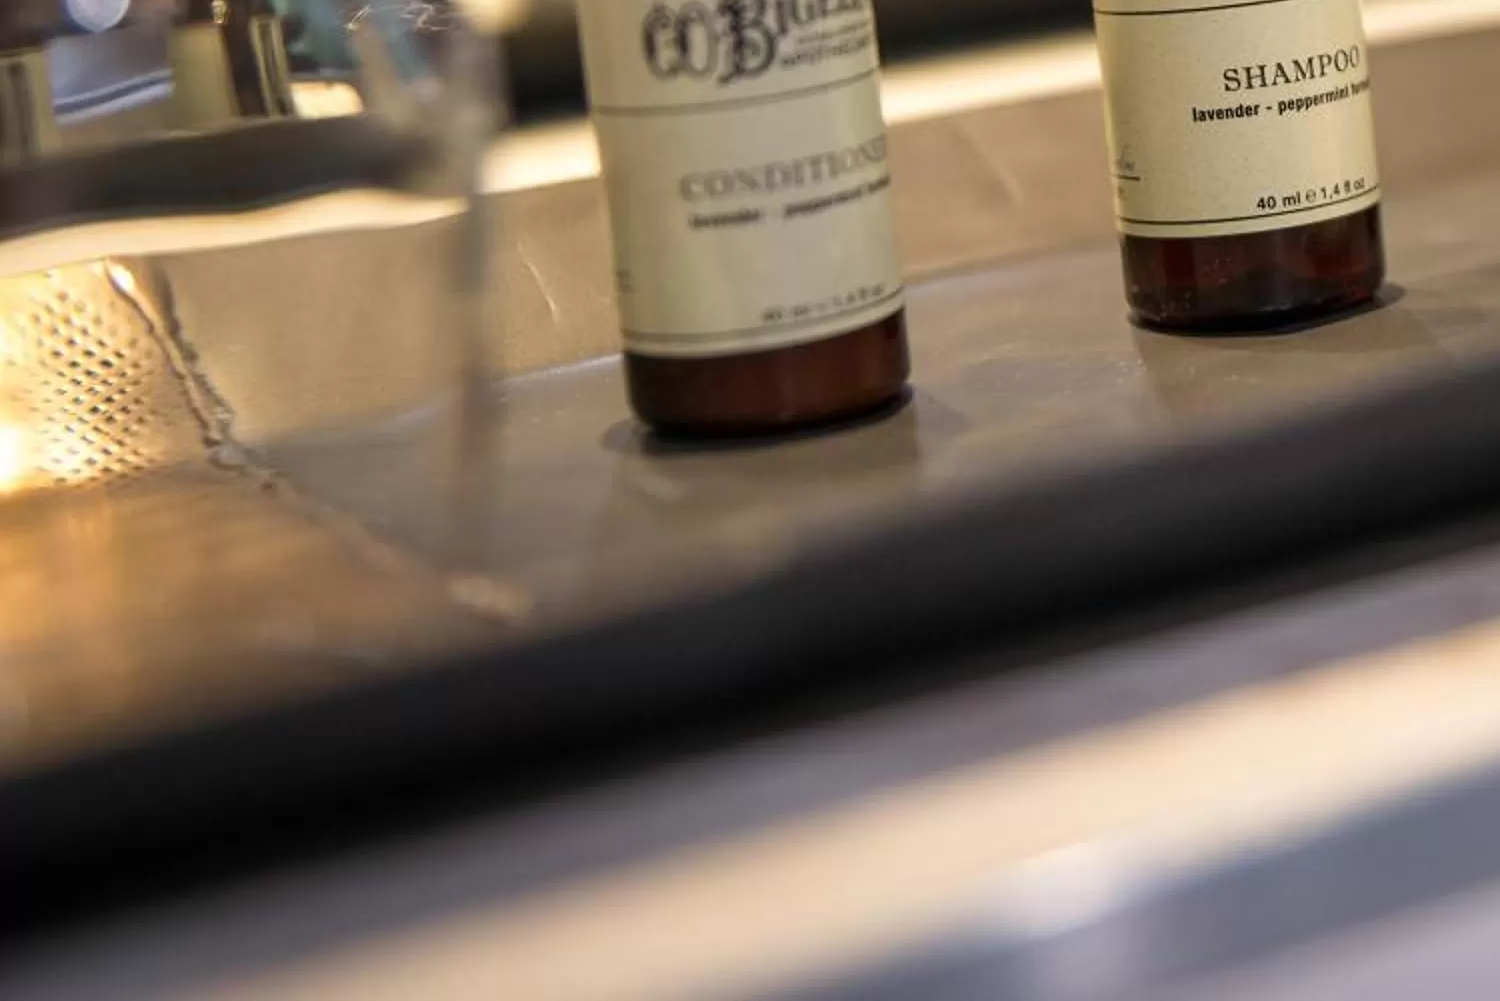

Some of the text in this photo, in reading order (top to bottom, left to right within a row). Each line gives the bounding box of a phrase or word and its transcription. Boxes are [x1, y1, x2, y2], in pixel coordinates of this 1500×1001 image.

[1223, 45, 1361, 93] SHAMPOO
[1192, 103, 1261, 123] lavender
[1278, 83, 1349, 116] peppermint
[1256, 196, 1277, 210] 40
[1283, 191, 1300, 207] ml
